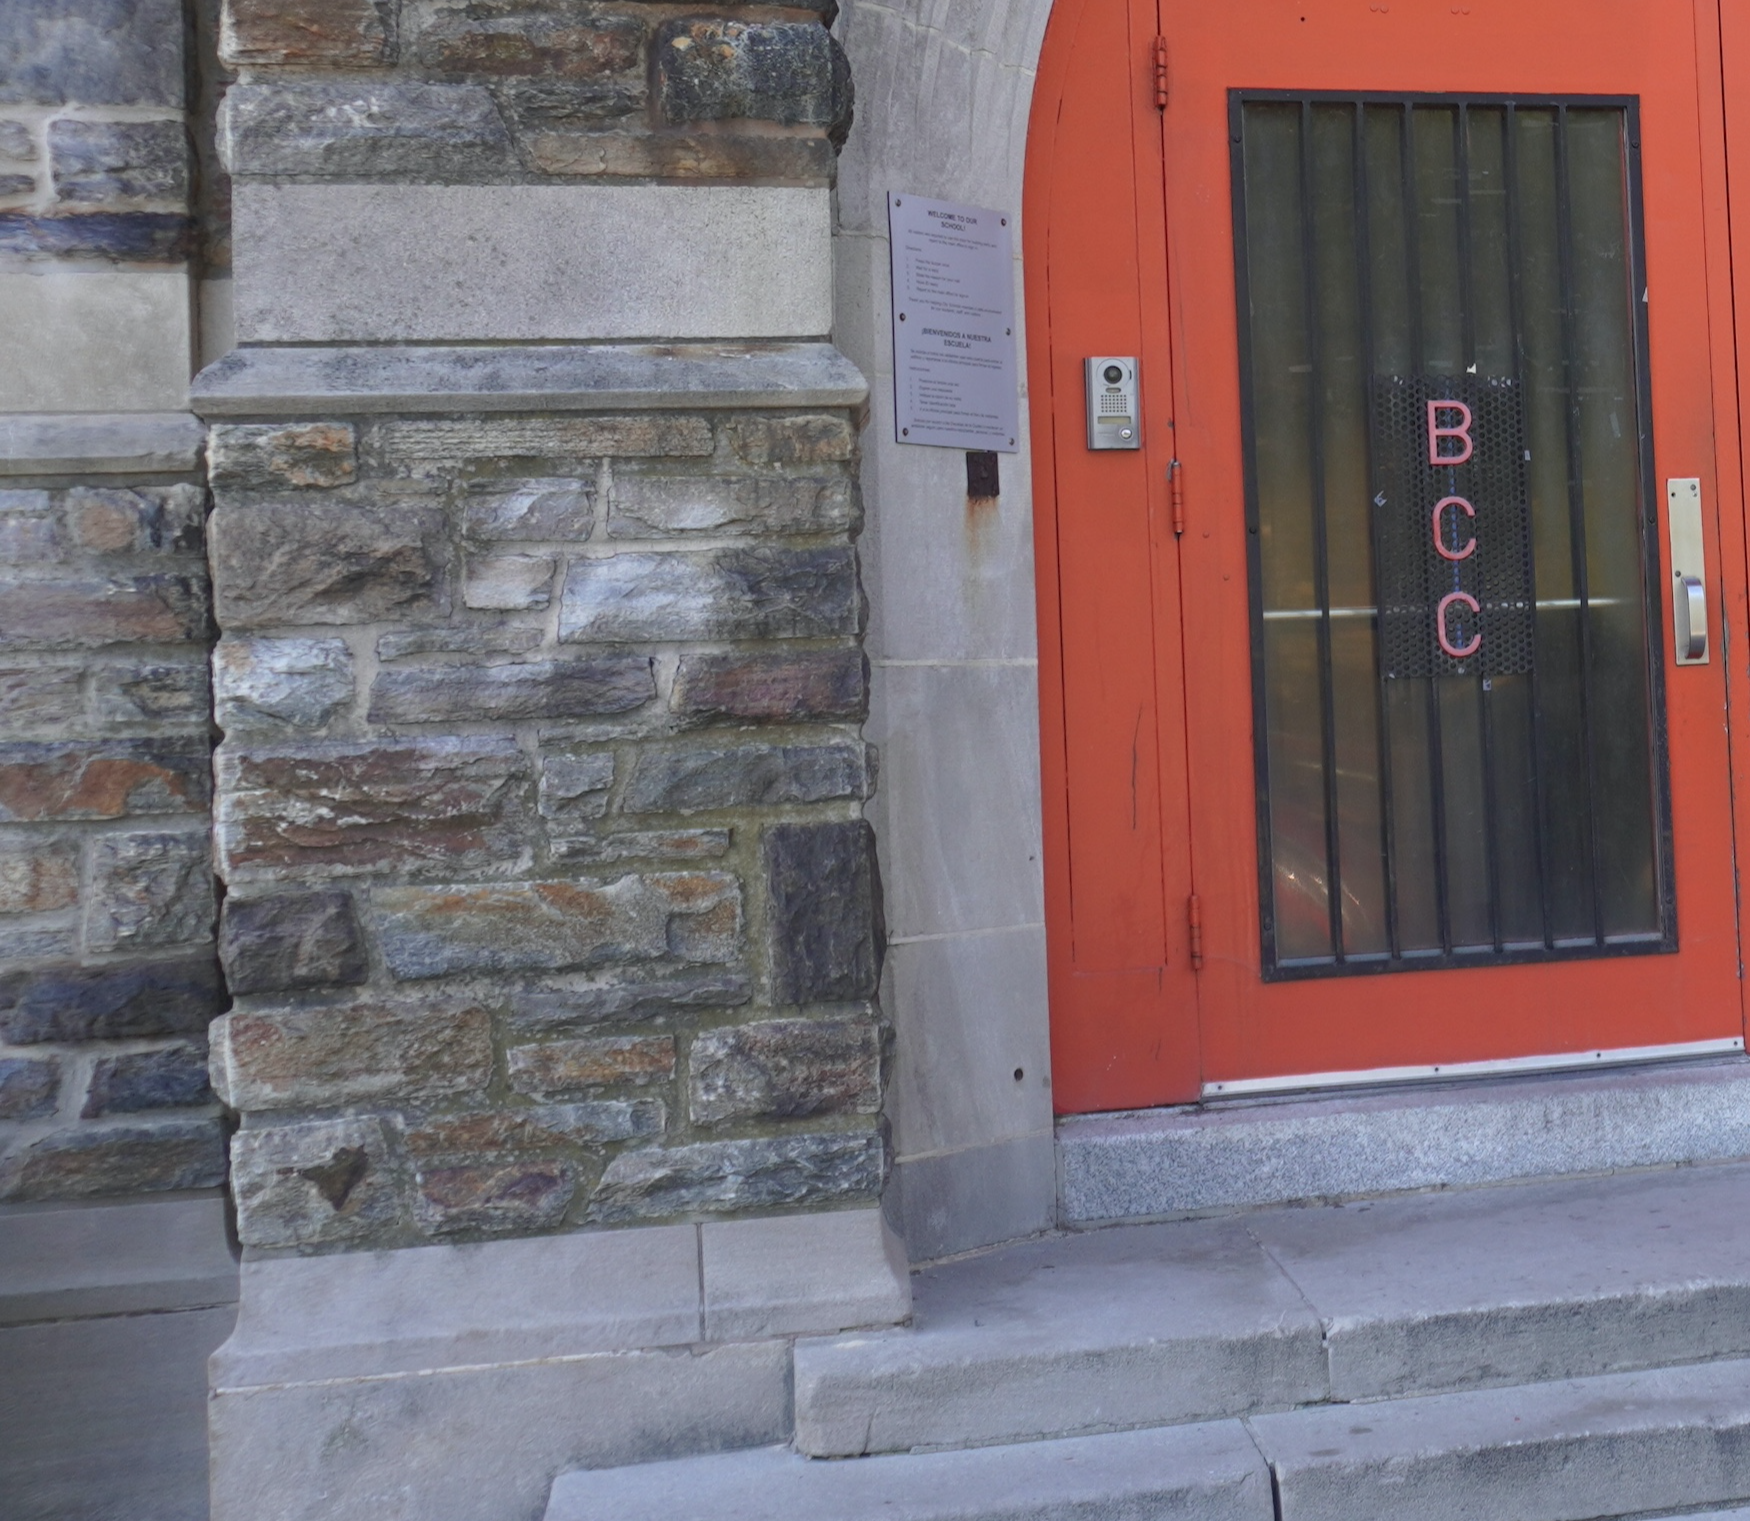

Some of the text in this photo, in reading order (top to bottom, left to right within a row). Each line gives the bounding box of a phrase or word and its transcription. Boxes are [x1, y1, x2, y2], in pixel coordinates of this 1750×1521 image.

[928, 210, 956, 221] WELCOME
[966, 216, 977, 225] OUR
[941, 221, 966, 231] SCHOOL!
[967, 333, 992, 343] NUESTRA
[944, 340, 971, 349] ESCUELA!
[1426, 399, 1483, 658] BCC
